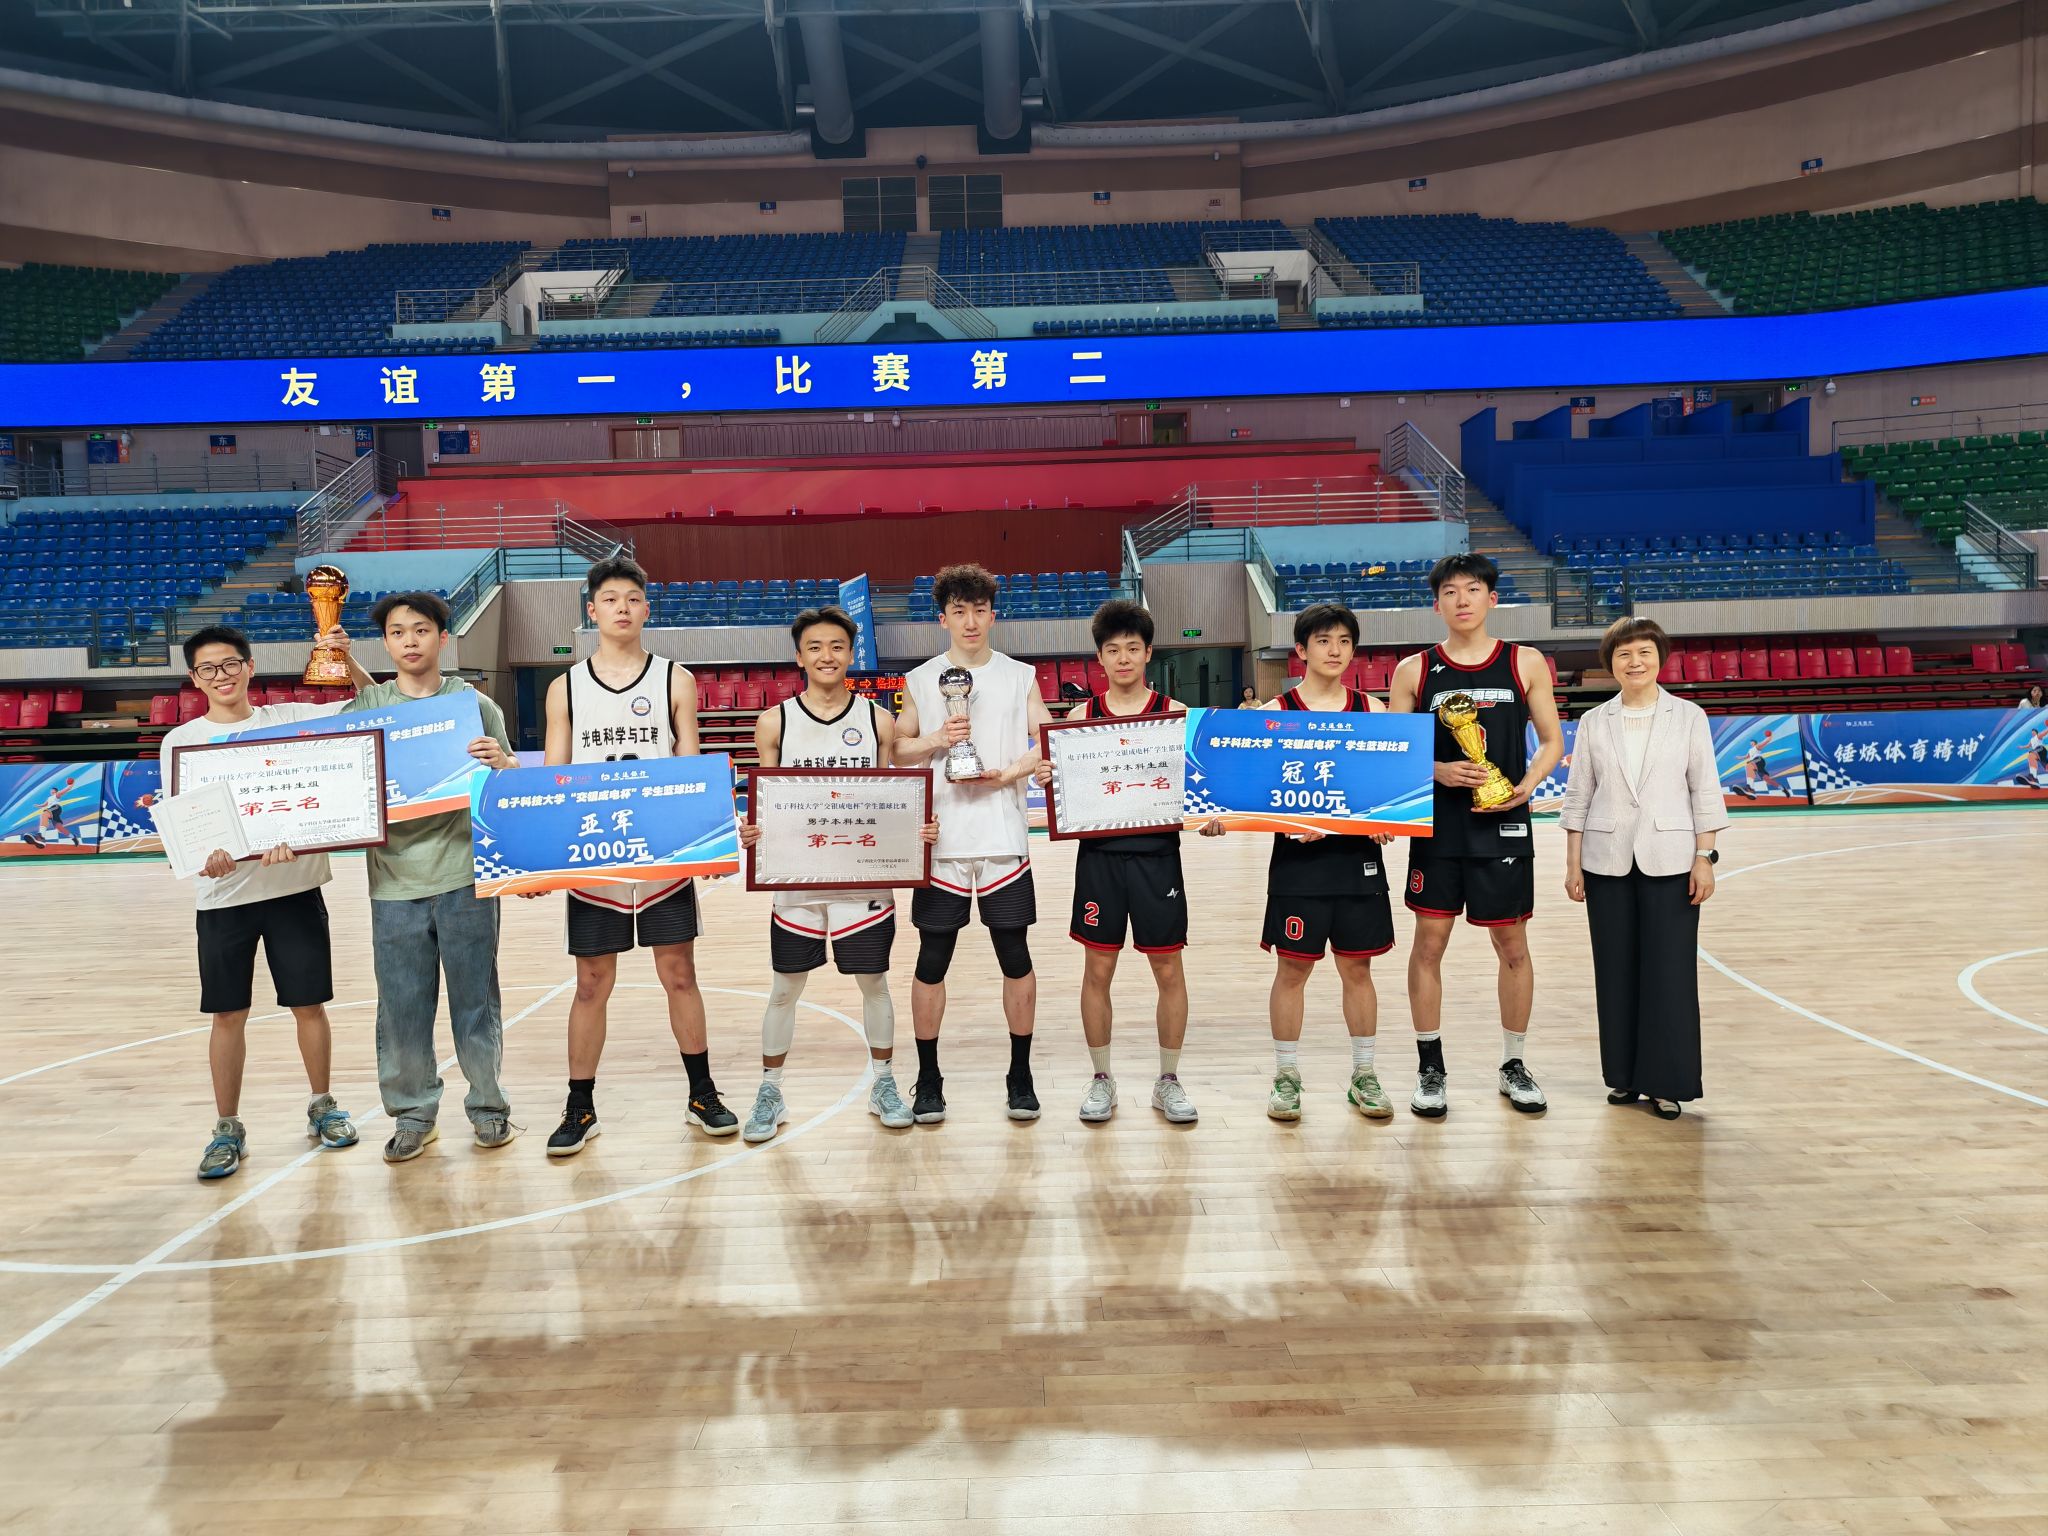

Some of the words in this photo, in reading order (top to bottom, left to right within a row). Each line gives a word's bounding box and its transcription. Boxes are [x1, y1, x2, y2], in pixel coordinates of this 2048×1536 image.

[218, 435, 229, 446] 东
[389, 719, 456, 742] 学生篮球比赛
[581, 726, 659, 748] 光电科学与工程
[1067, 743, 1186, 762] 电子科技大学“交银成电杯”学生篮球
[1834, 738, 1979, 764] 锤炼体育精神
[1100, 761, 1169, 774] 男子本科生组
[1281, 759, 1337, 787] 冠军
[238, 781, 320, 795] 男子本科生组
[1101, 776, 1171, 795] 第一名
[240, 796, 320, 817] 第三名
[1270, 789, 1347, 810] 3000元
[578, 809, 635, 837] 亚军
[807, 817, 877, 826] 男子本科生组
[567, 837, 649, 863] 2000元
[807, 833, 877, 848] 第二名
[1410, 869, 1424, 893] 8
[1084, 901, 1099, 927] 2
[1285, 916, 1304, 941] 0
